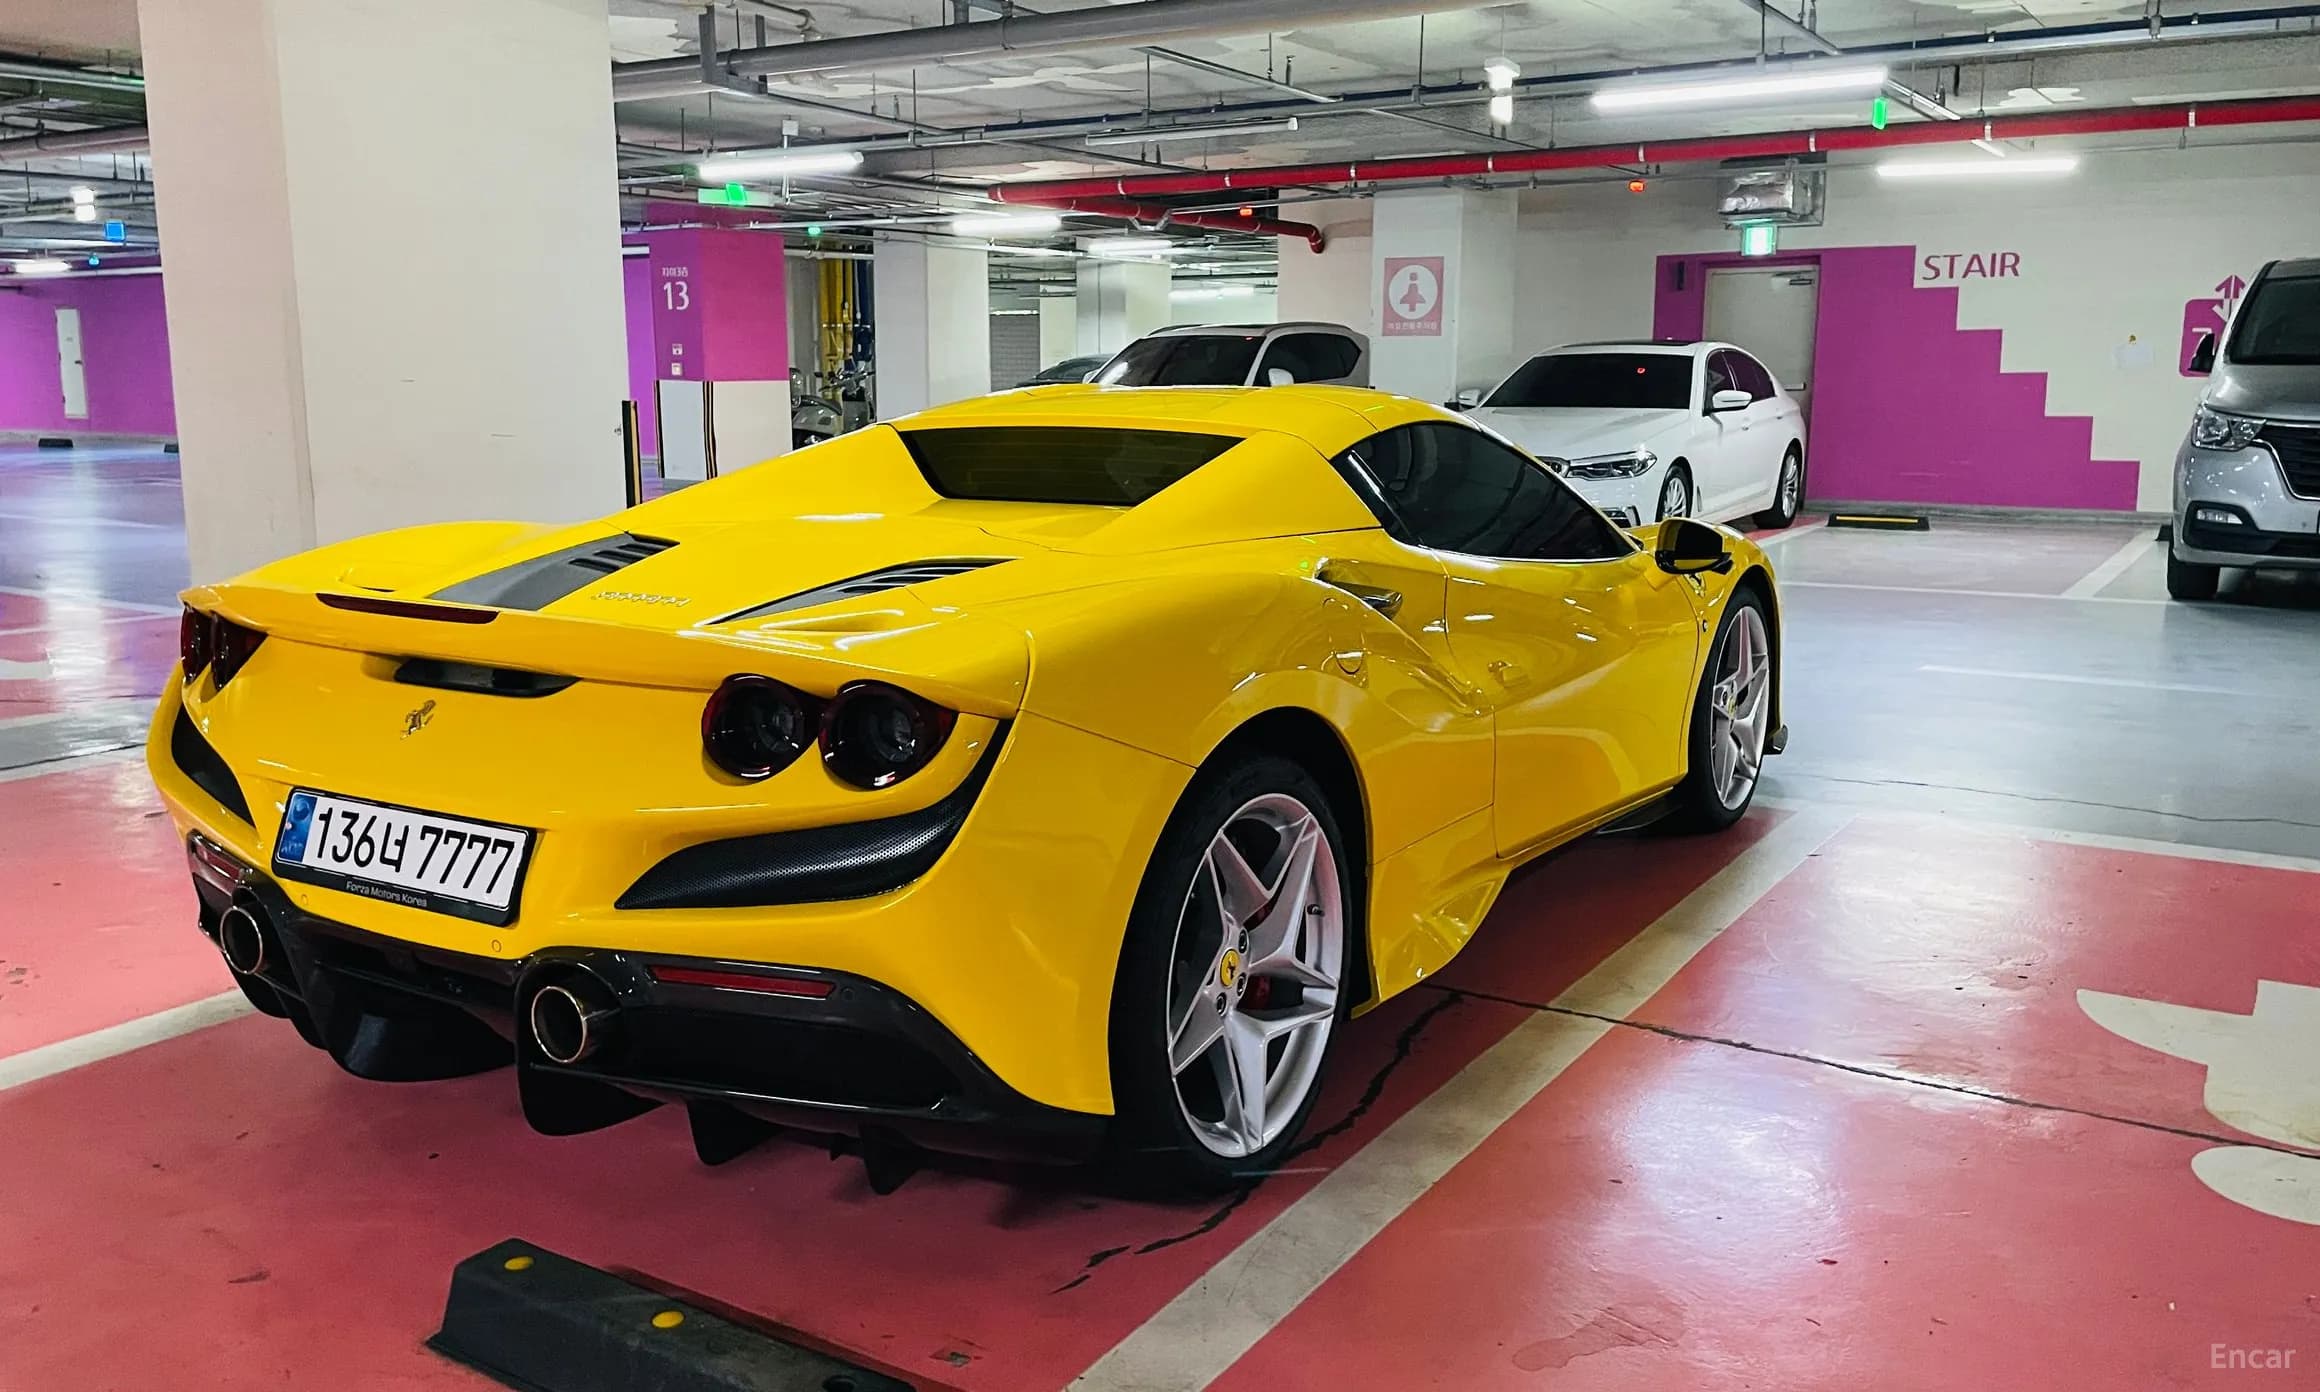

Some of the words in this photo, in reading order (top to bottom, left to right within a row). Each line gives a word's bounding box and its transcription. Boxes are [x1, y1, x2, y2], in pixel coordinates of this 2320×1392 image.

[1922, 252, 2020, 280] STAIR
[663, 281, 690, 310] 13
[318, 806, 410, 873] 136너
[415, 824, 516, 894] 7777
[346, 880, 370, 895] Forza
[370, 886, 401, 902] Motors
[401, 893, 428, 908] Korea
